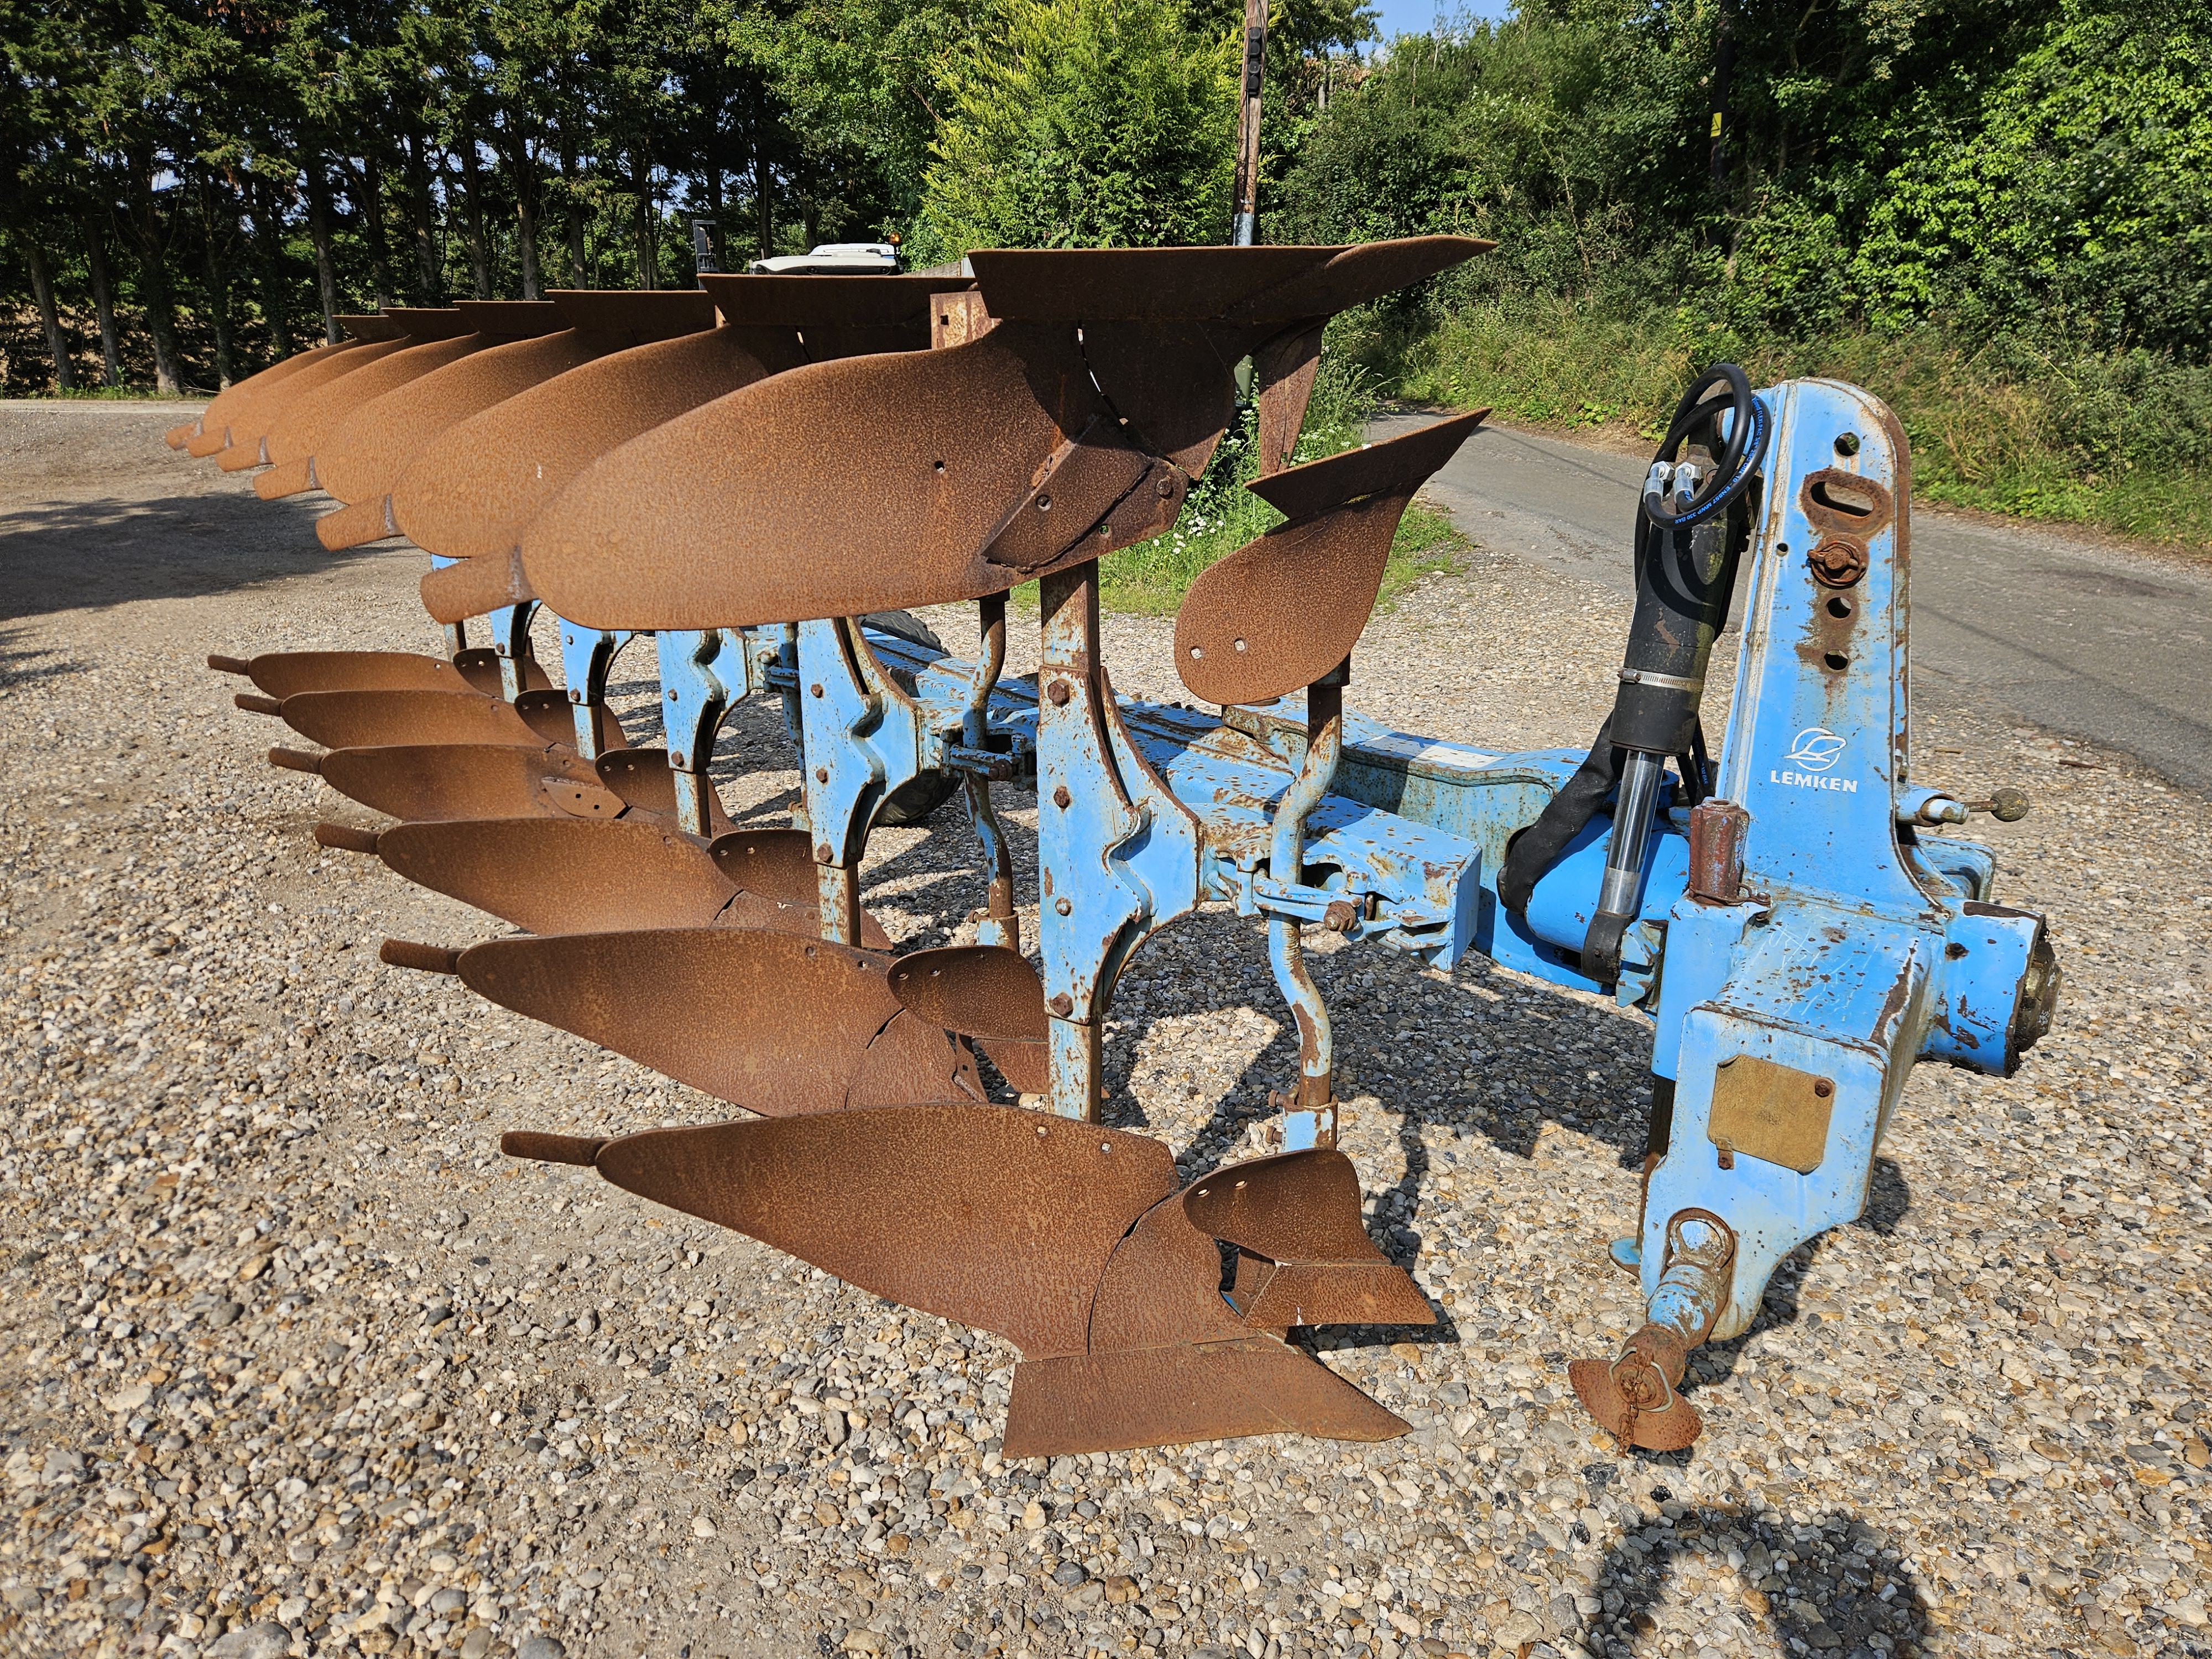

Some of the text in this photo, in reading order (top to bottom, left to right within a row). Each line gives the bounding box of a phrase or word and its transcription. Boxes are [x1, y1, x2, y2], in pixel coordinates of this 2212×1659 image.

[1738, 462, 1749, 474] DIN
[1697, 502, 1712, 514] MWP
[1770, 769, 1858, 793] LEMKEN
